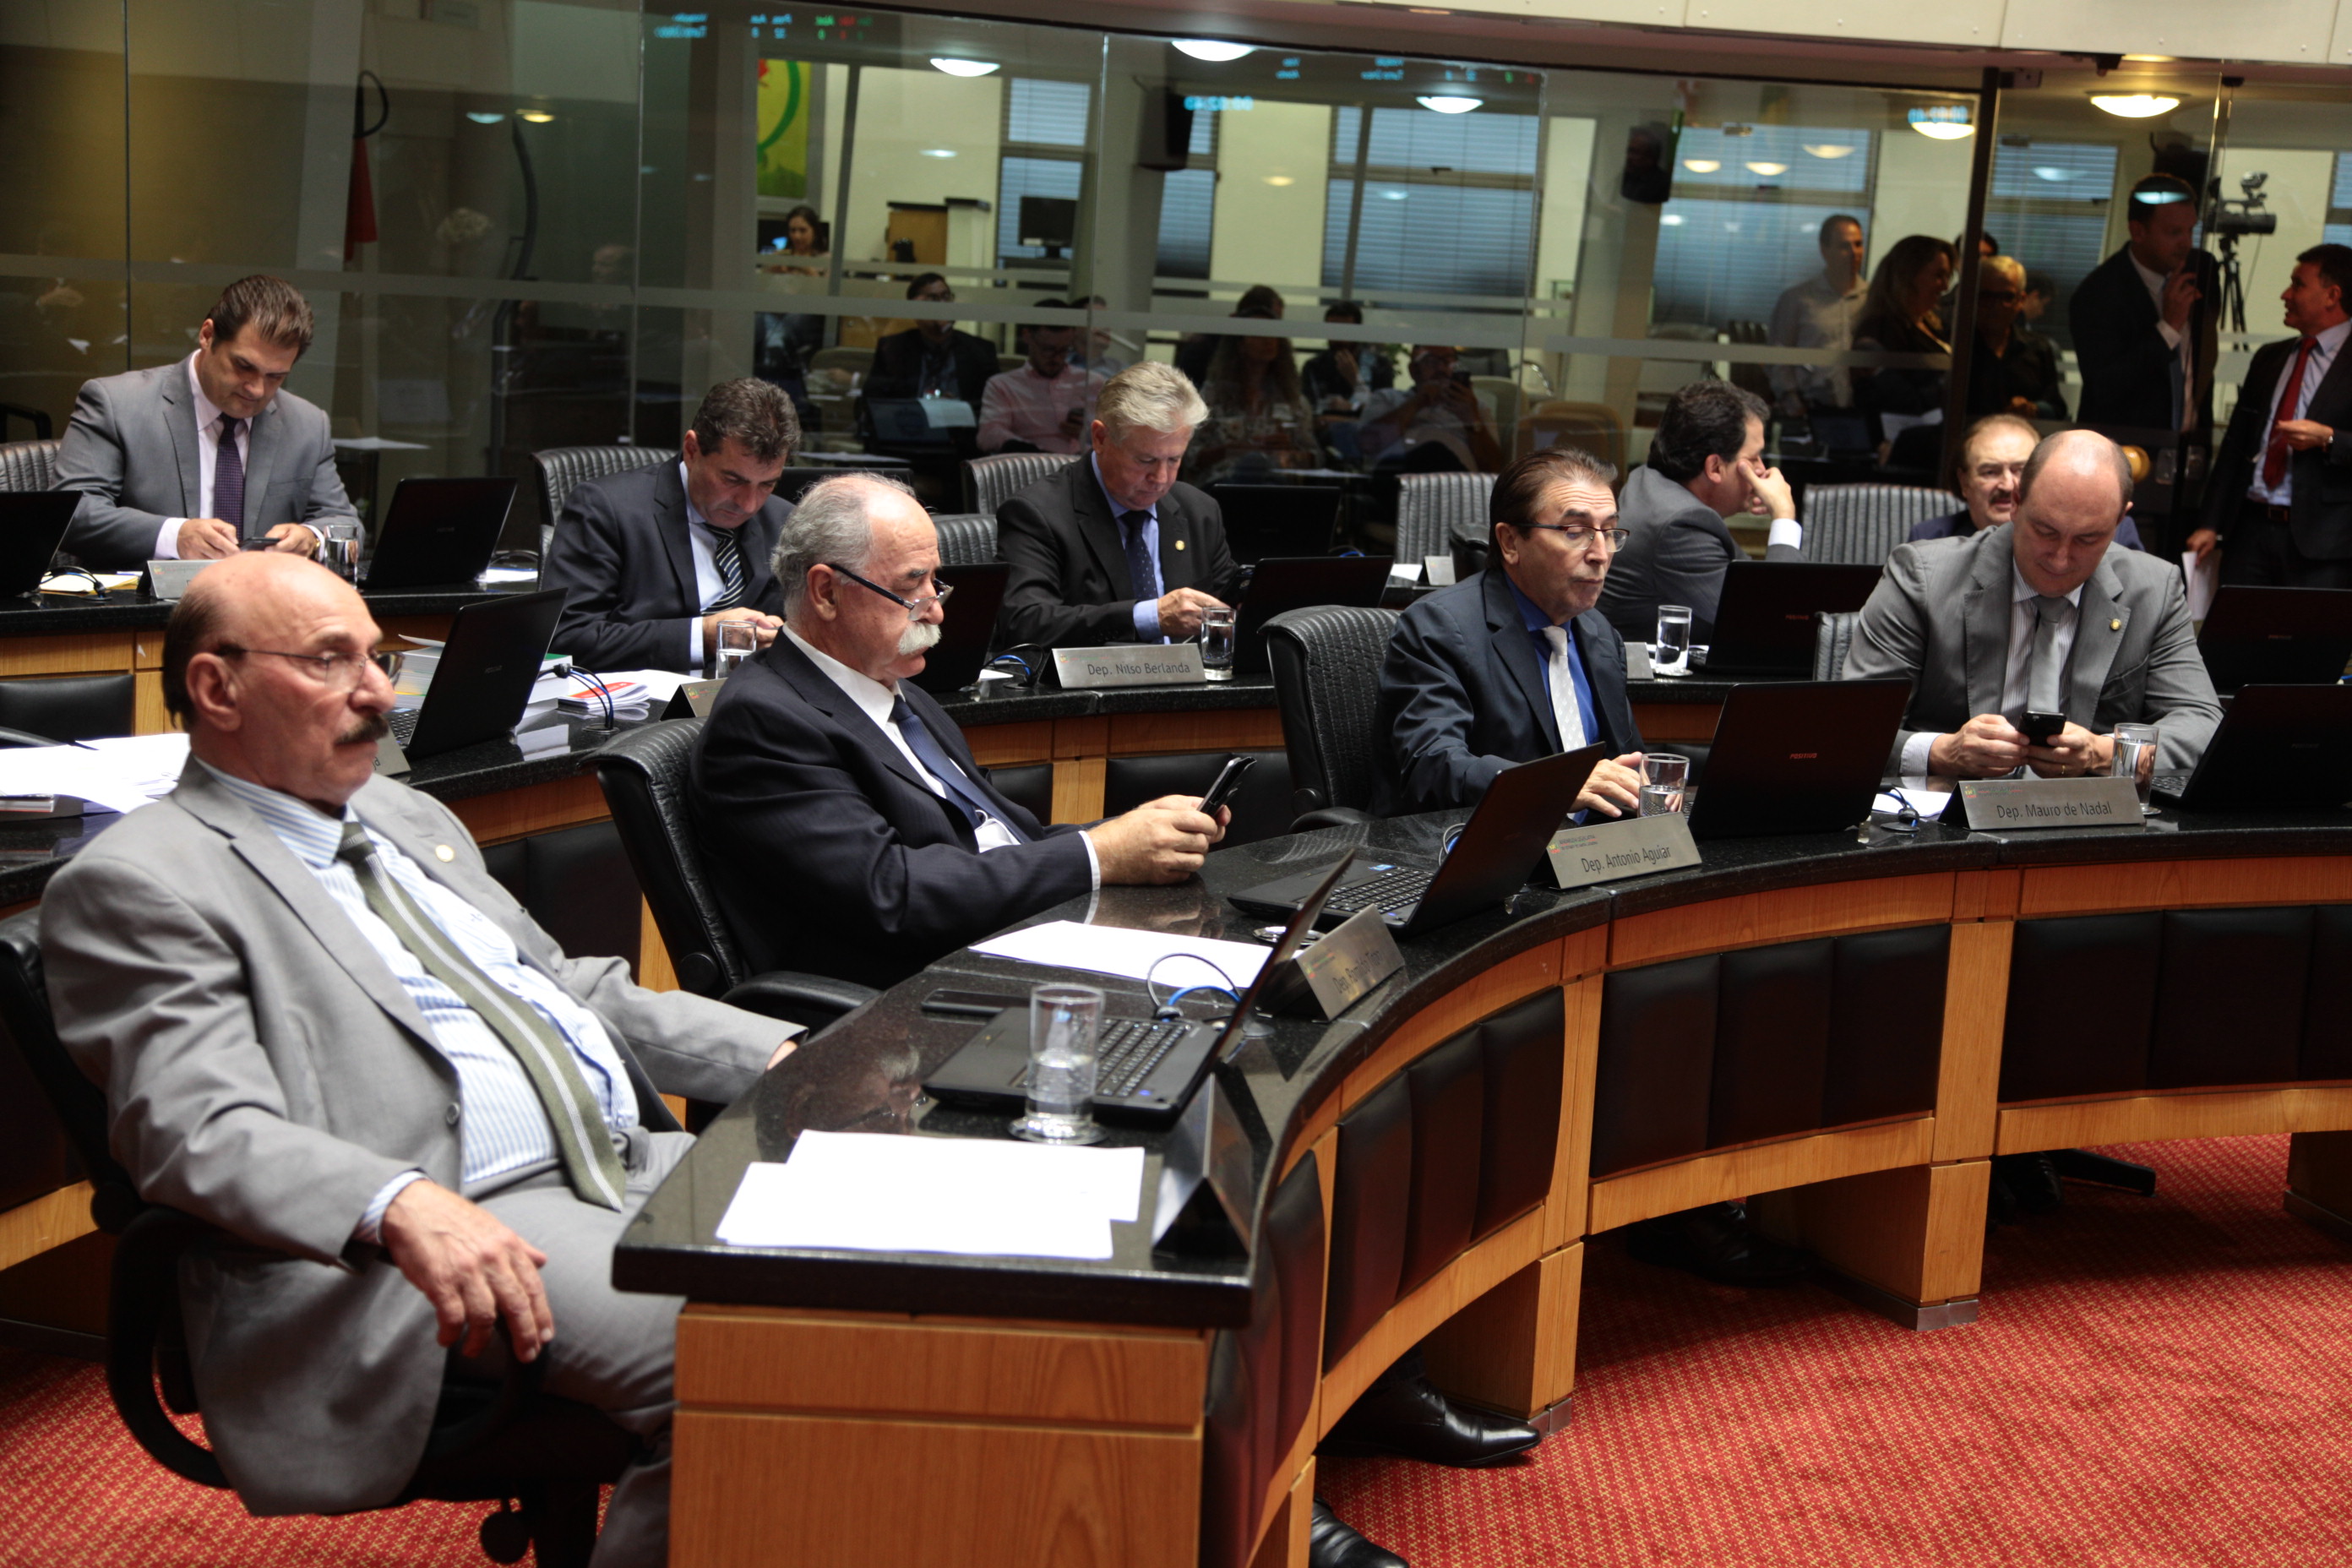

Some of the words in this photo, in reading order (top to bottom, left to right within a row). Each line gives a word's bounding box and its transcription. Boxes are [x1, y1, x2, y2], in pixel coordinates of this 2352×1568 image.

[1087, 663, 1113, 678] Dep.
[1115, 663, 1141, 675] Nilso
[1144, 662, 1190, 674] Berlanda
[1996, 804, 2023, 821] Dep.
[2025, 803, 2061, 818] Mauro
[2064, 803, 2077, 816] de
[2079, 801, 2112, 816] Nadal
[1581, 858, 1605, 874] Dep.
[1605, 849, 1641, 869] Antonio
[1642, 845, 1671, 865] Aguiar
